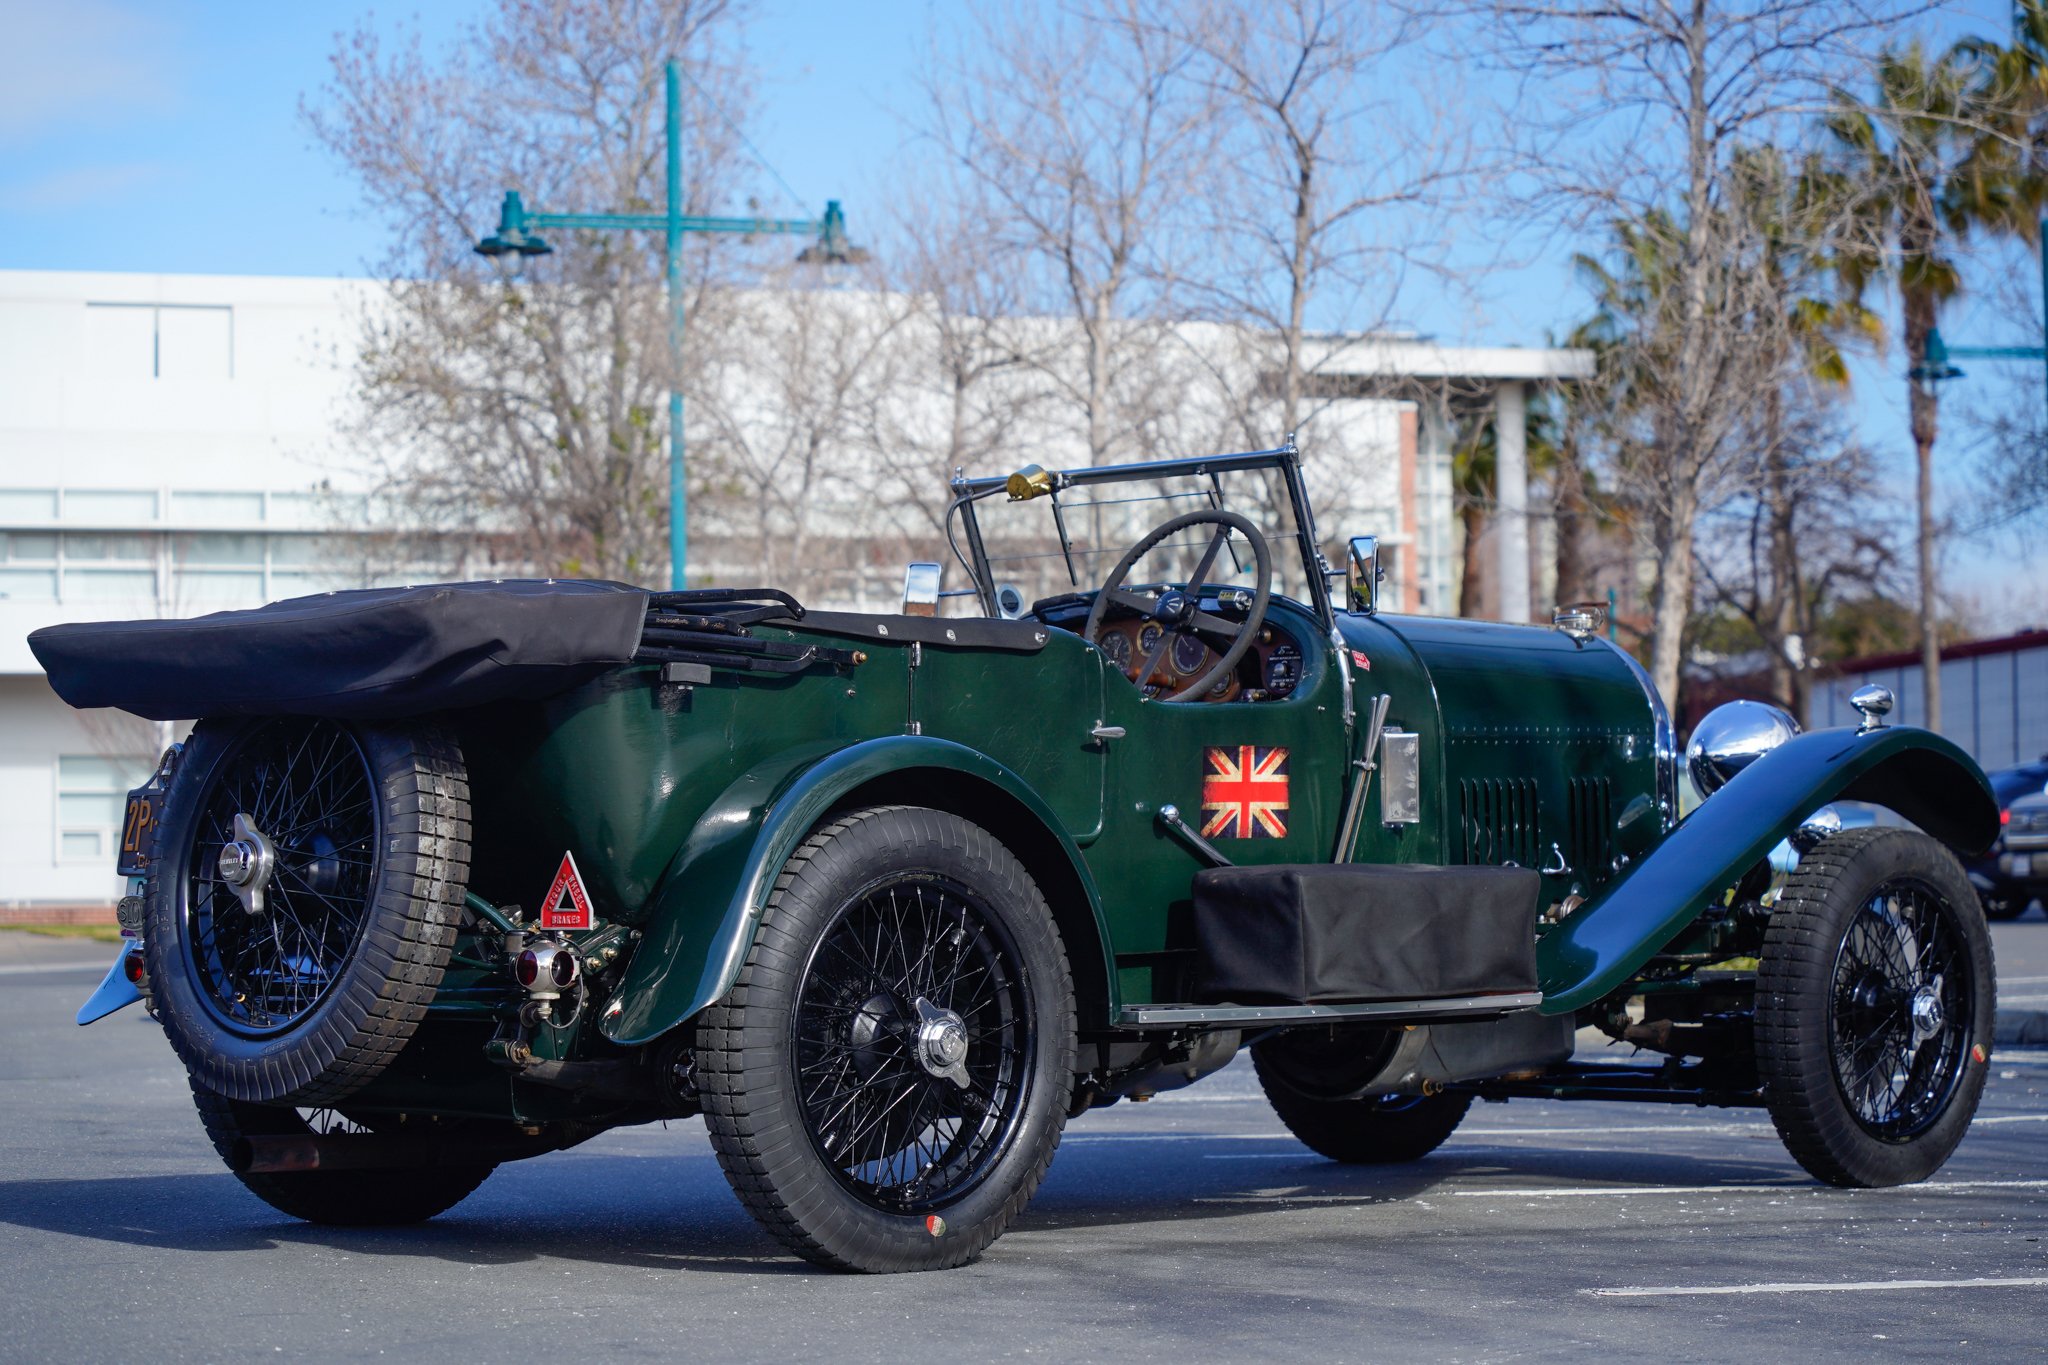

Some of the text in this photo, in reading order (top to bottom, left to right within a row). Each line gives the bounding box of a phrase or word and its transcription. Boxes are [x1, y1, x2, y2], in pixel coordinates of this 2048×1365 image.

[124, 800, 157, 852] 2P
[568, 874, 585, 909] WHEEL
[551, 915, 580, 925] BRAKES
